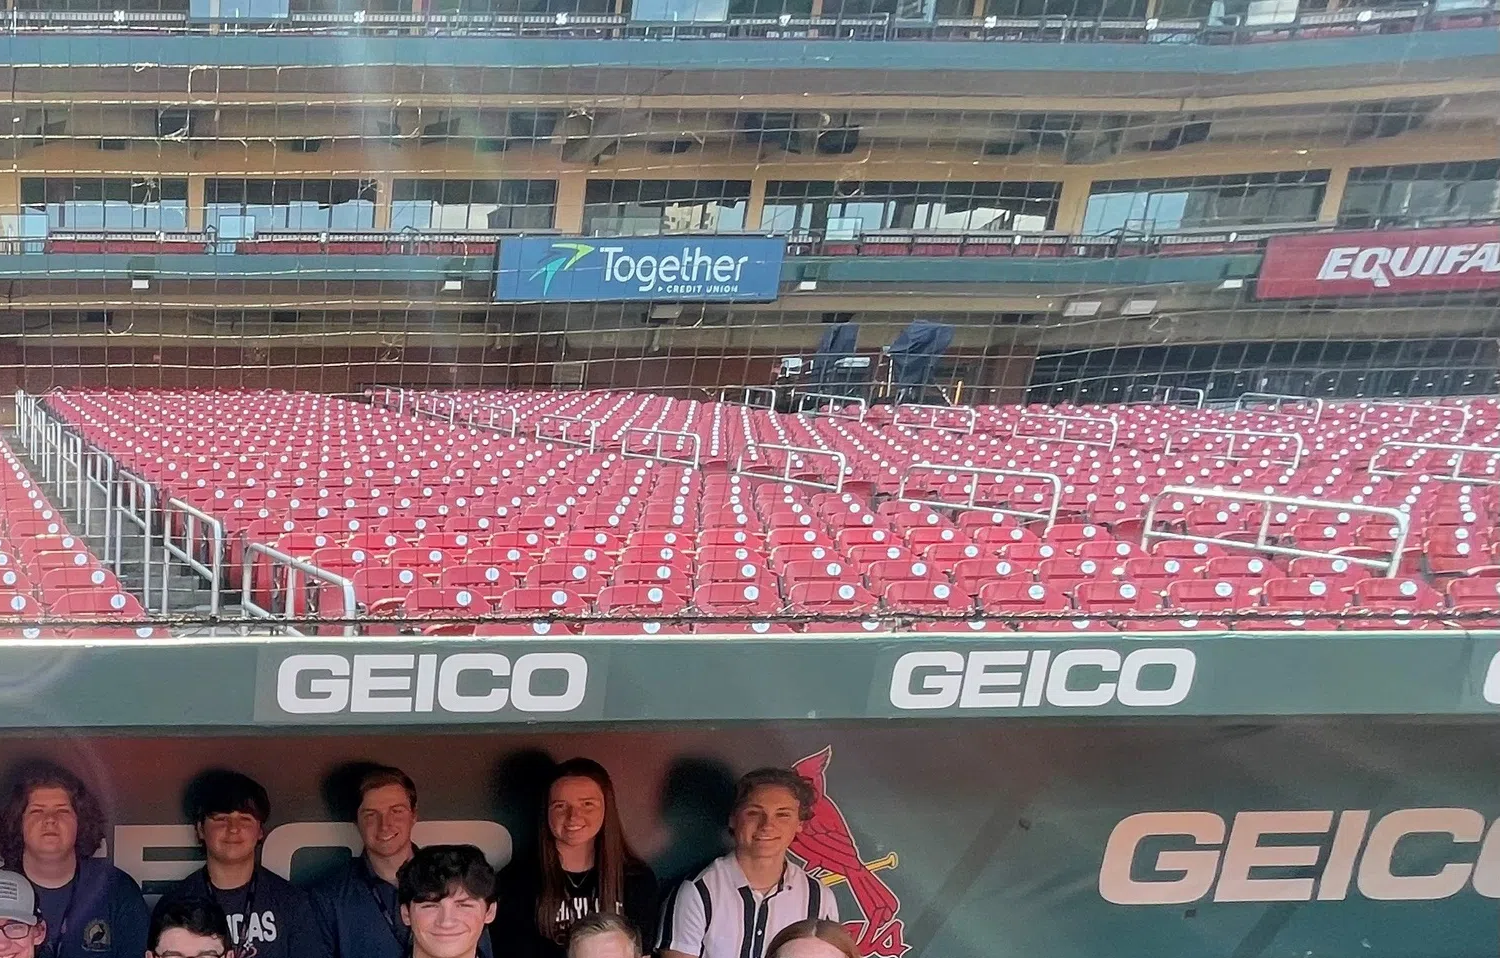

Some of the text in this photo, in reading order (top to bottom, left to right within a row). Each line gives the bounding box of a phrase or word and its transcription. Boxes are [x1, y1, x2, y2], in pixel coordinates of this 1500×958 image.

[600, 246, 749, 292] Together
[666, 284, 738, 294] CREDIT UNION
[276, 652, 589, 714] GEICO
[890, 648, 1196, 710] GEICO
[1098, 806, 1500, 906] GEIC
